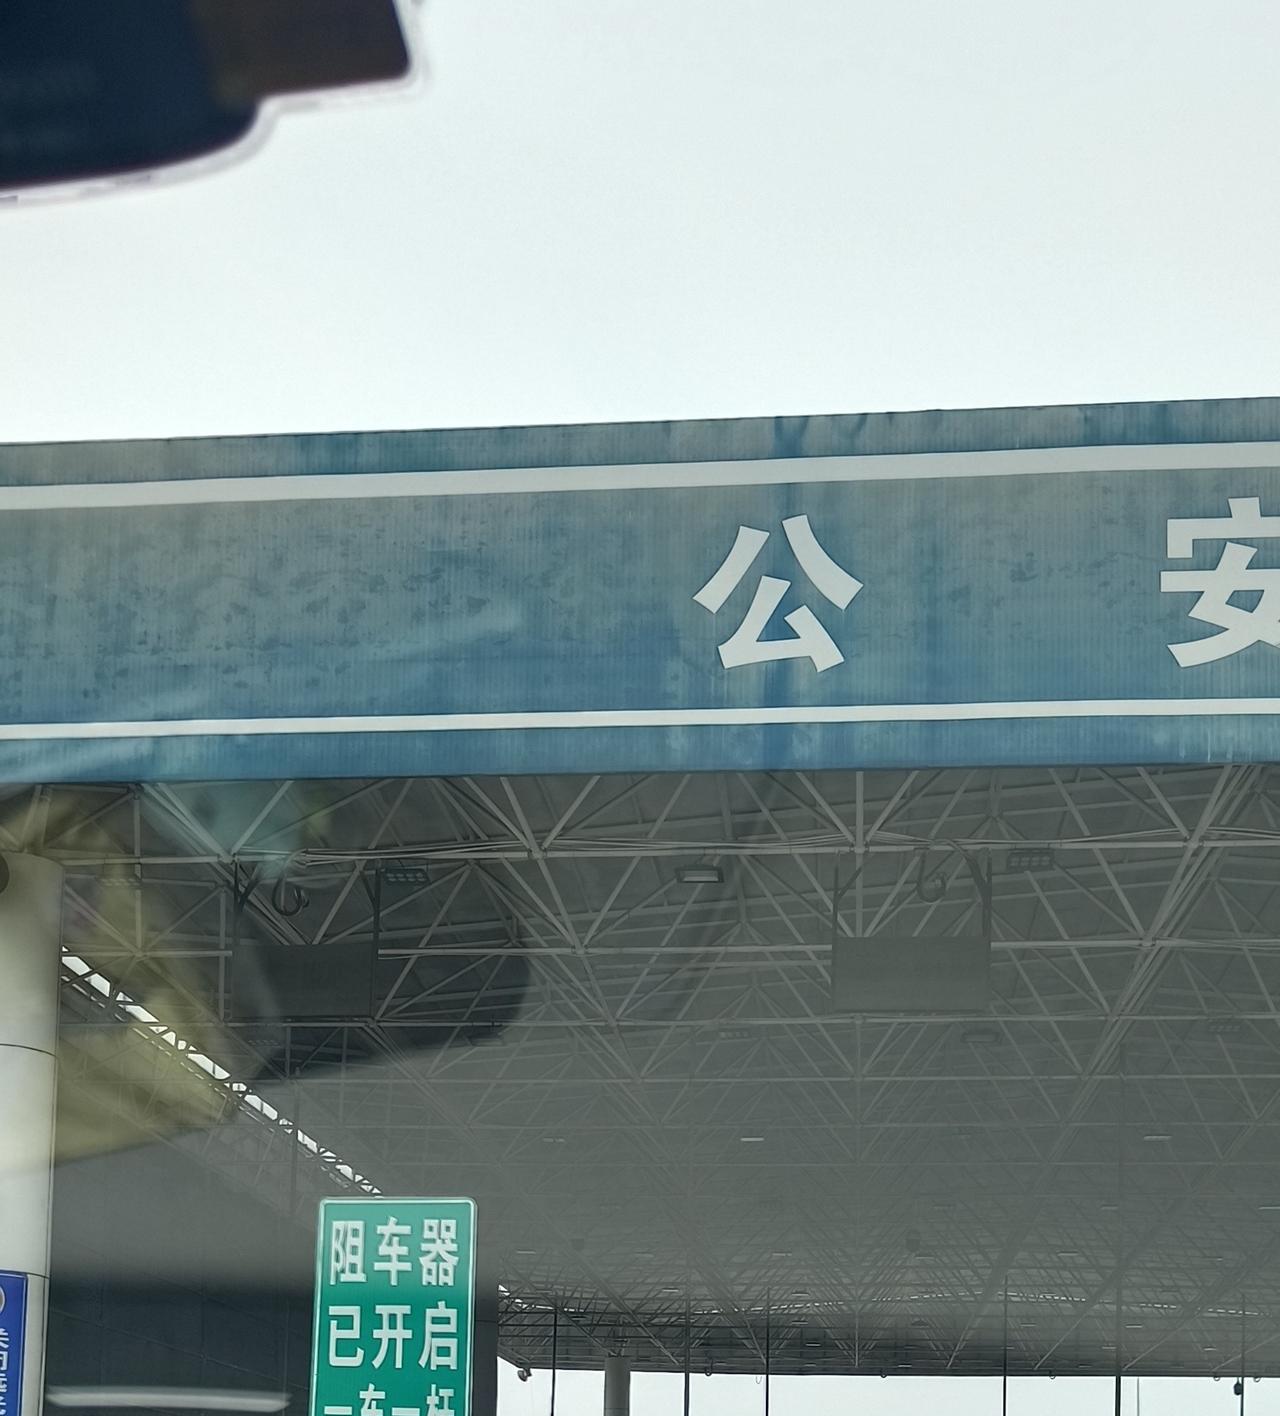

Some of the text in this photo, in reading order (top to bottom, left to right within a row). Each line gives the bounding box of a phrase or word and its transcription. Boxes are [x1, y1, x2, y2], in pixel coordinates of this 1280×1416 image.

[692, 496, 1280, 673] 公安
[330, 1216, 459, 1287] 阻车器
[328, 1301, 458, 1371] 已开启
